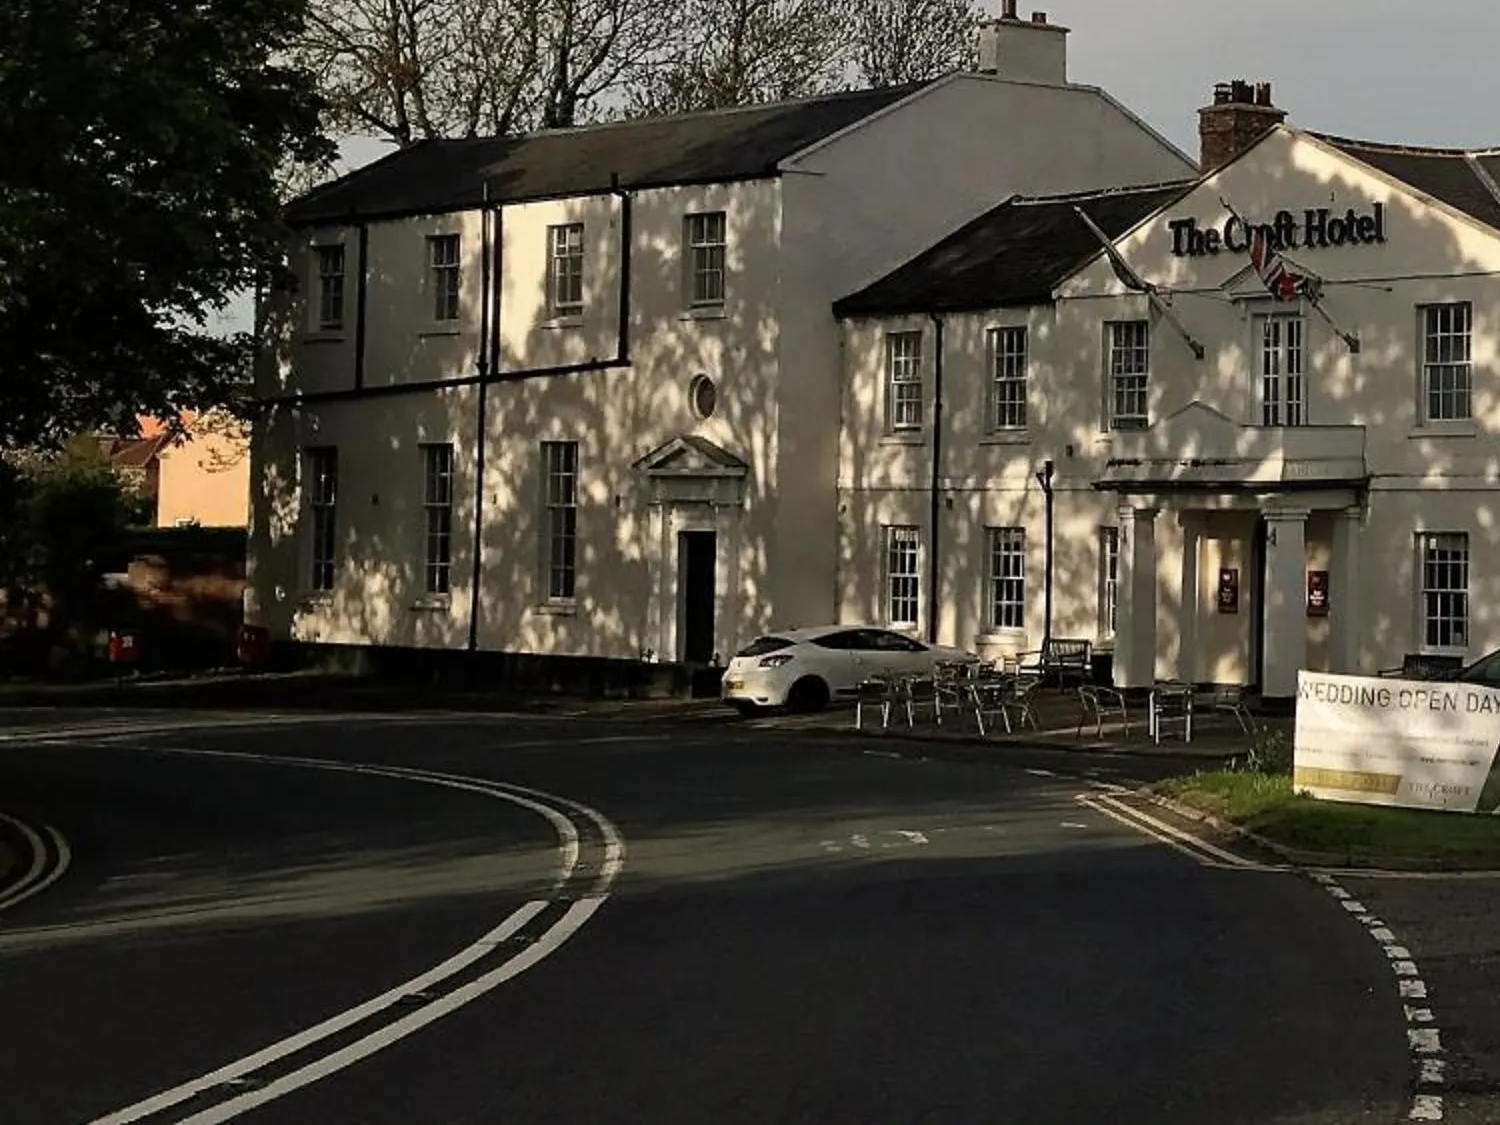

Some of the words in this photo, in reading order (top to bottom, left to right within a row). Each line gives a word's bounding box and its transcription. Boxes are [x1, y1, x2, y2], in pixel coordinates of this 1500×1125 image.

[1168, 217, 1221, 256] The
[1304, 202, 1385, 248] Hotel
[1399, 689, 1457, 711] OPEN
